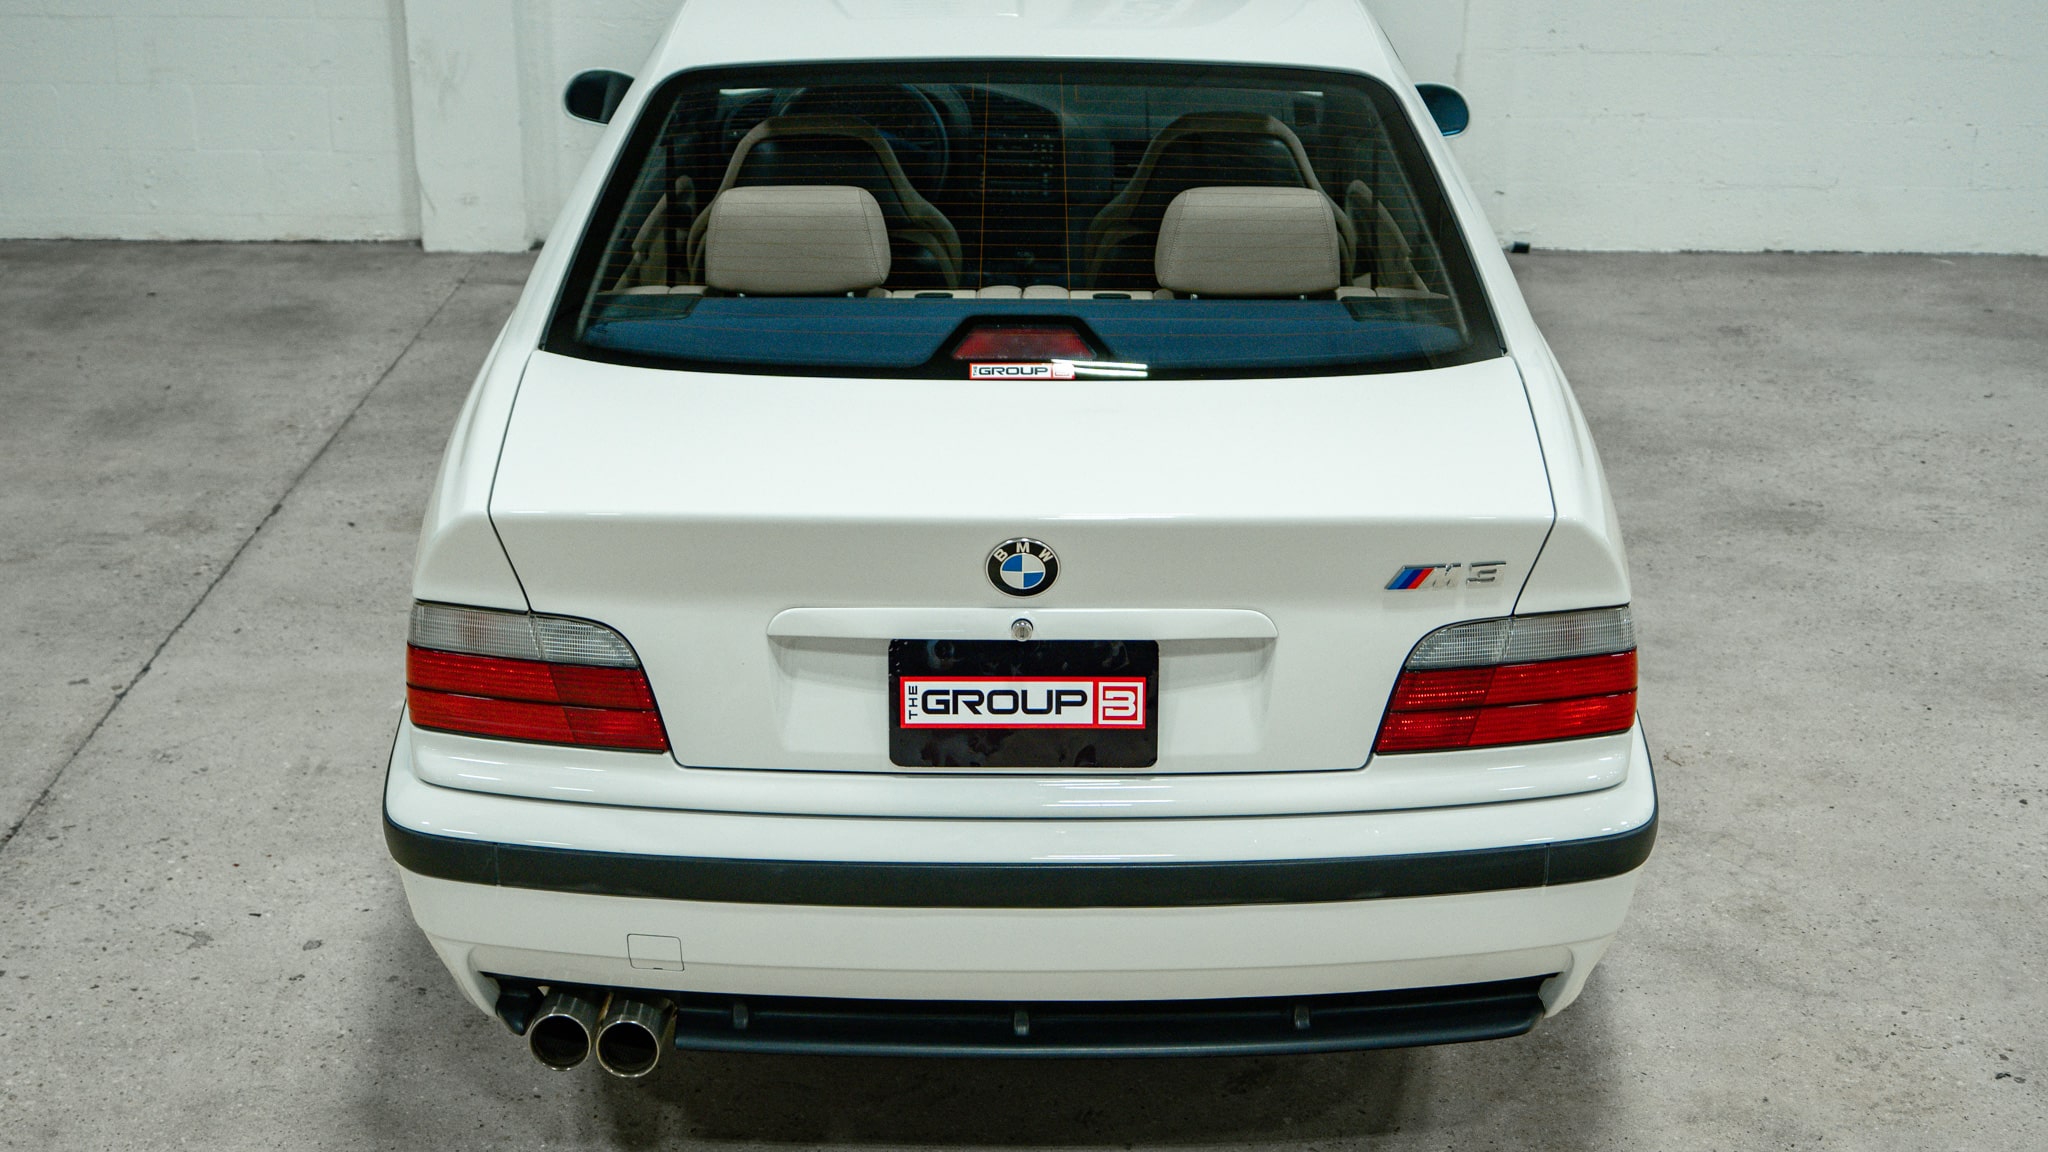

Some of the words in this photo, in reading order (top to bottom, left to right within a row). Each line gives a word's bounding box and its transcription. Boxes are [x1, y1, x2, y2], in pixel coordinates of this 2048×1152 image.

[978, 366, 1048, 376] GROUP
[993, 542, 1054, 562] BMW
[908, 685, 918, 720] THE
[921, 689, 1088, 715] GROUP
